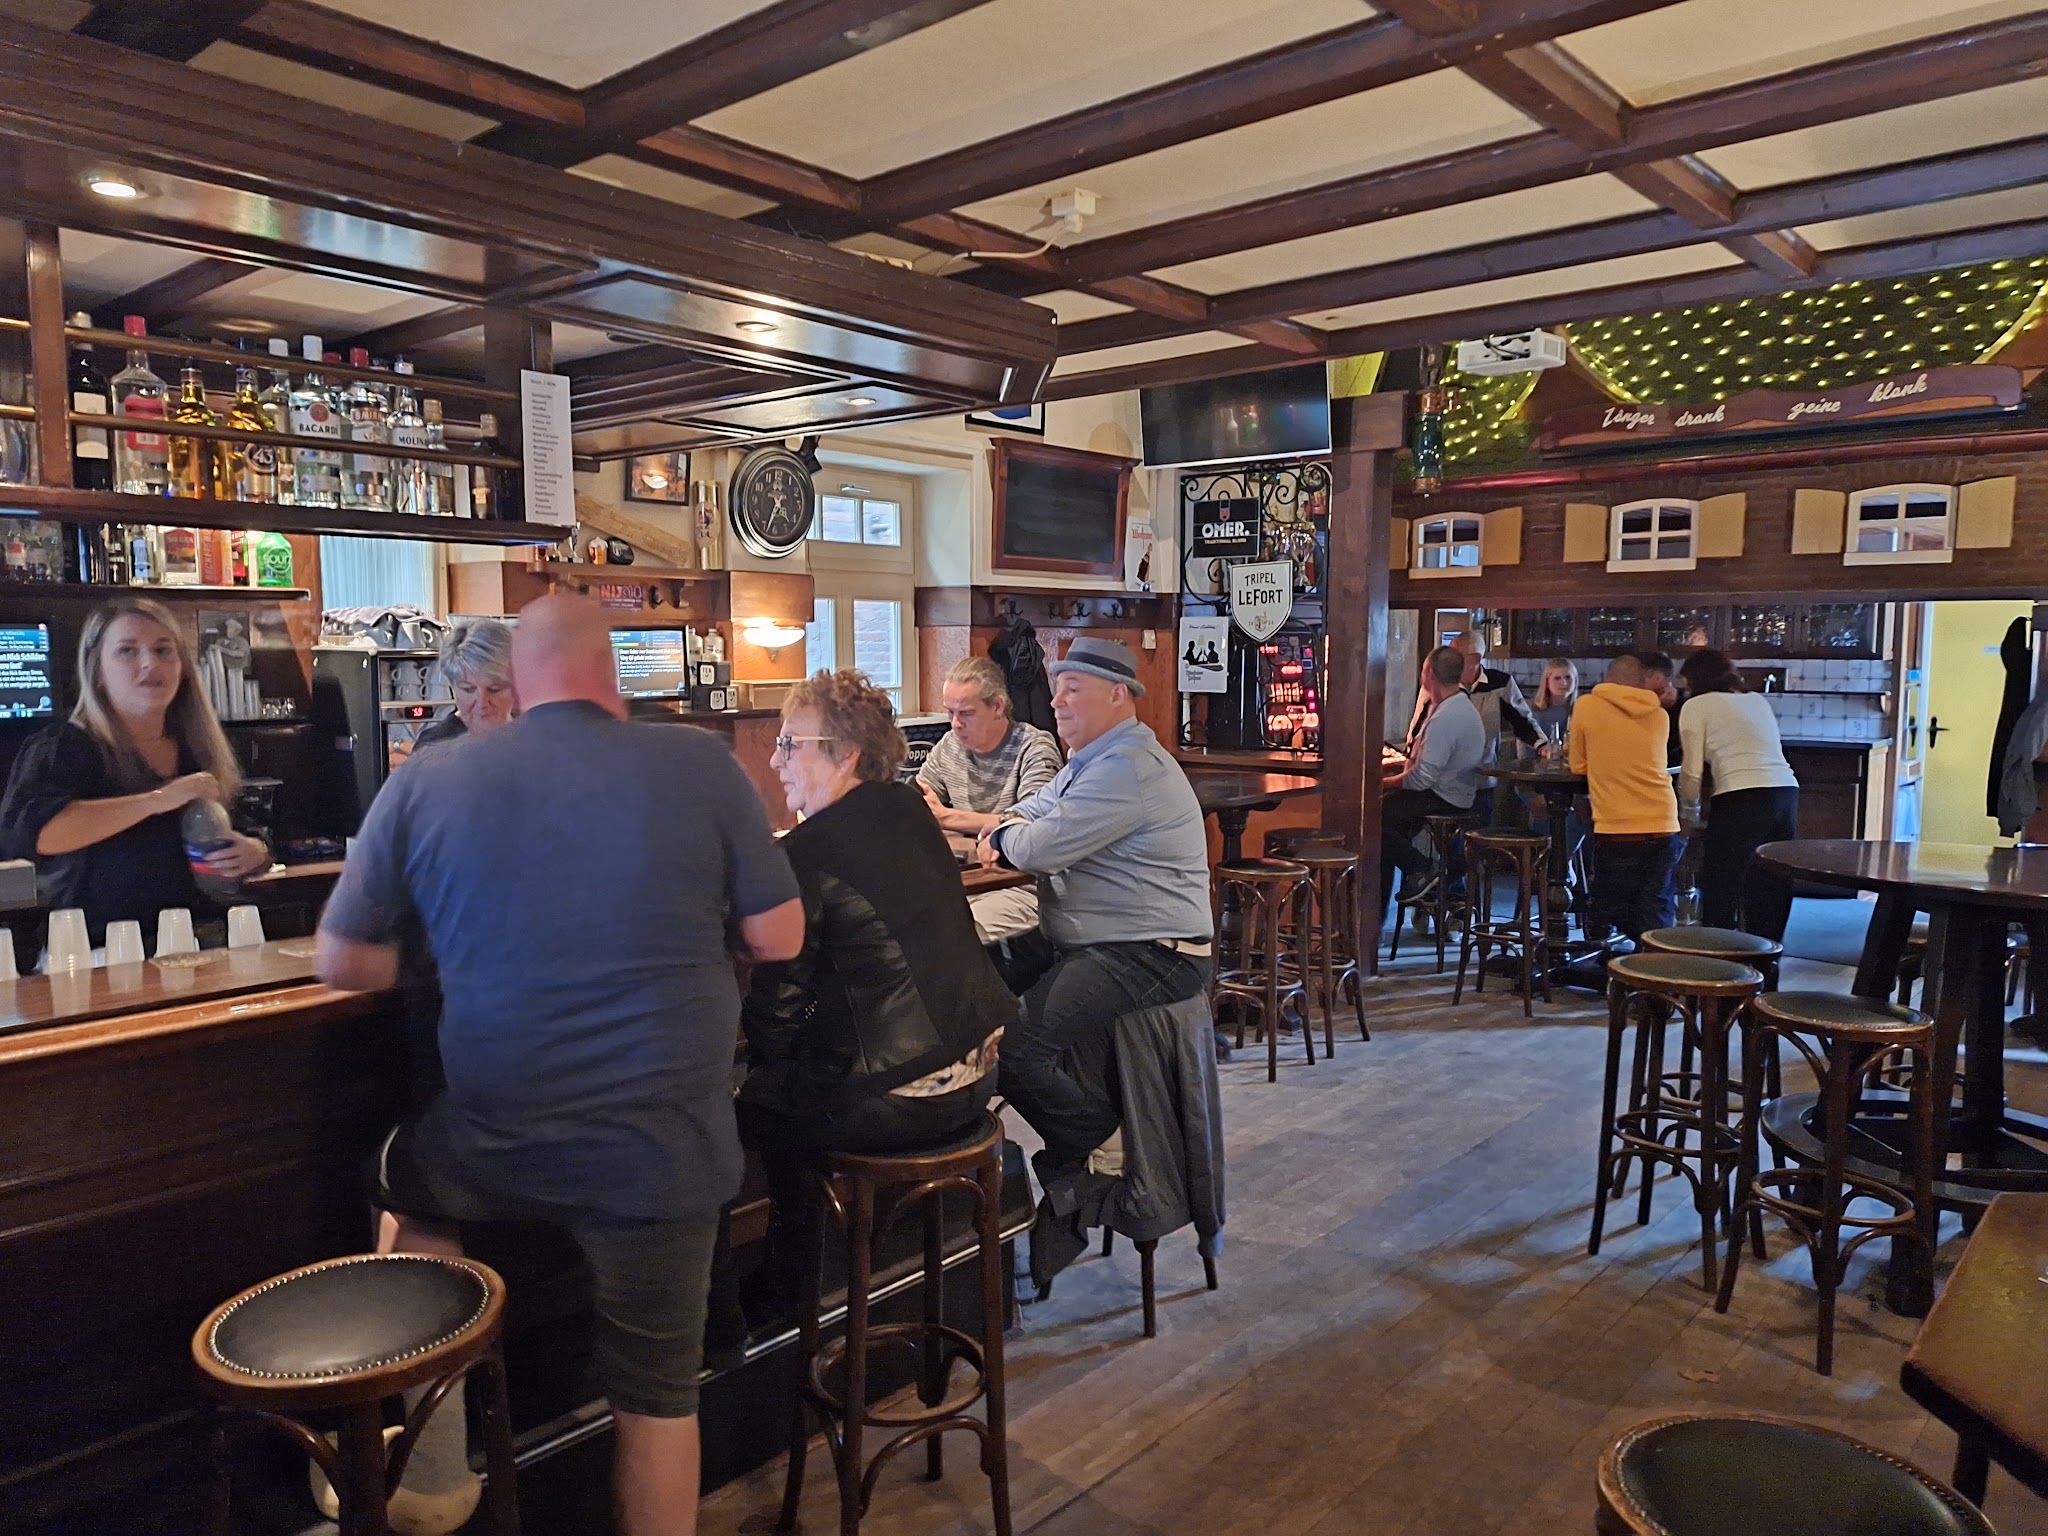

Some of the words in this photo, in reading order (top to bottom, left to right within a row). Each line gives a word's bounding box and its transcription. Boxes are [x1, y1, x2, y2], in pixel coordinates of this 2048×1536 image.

[399, 436, 429, 446] MOLIN
[253, 448, 273, 465] 43
[1202, 521, 1250, 538] OMER.
[1245, 572, 1276, 586] TRIPEL
[909, 749, 929, 761] opp
